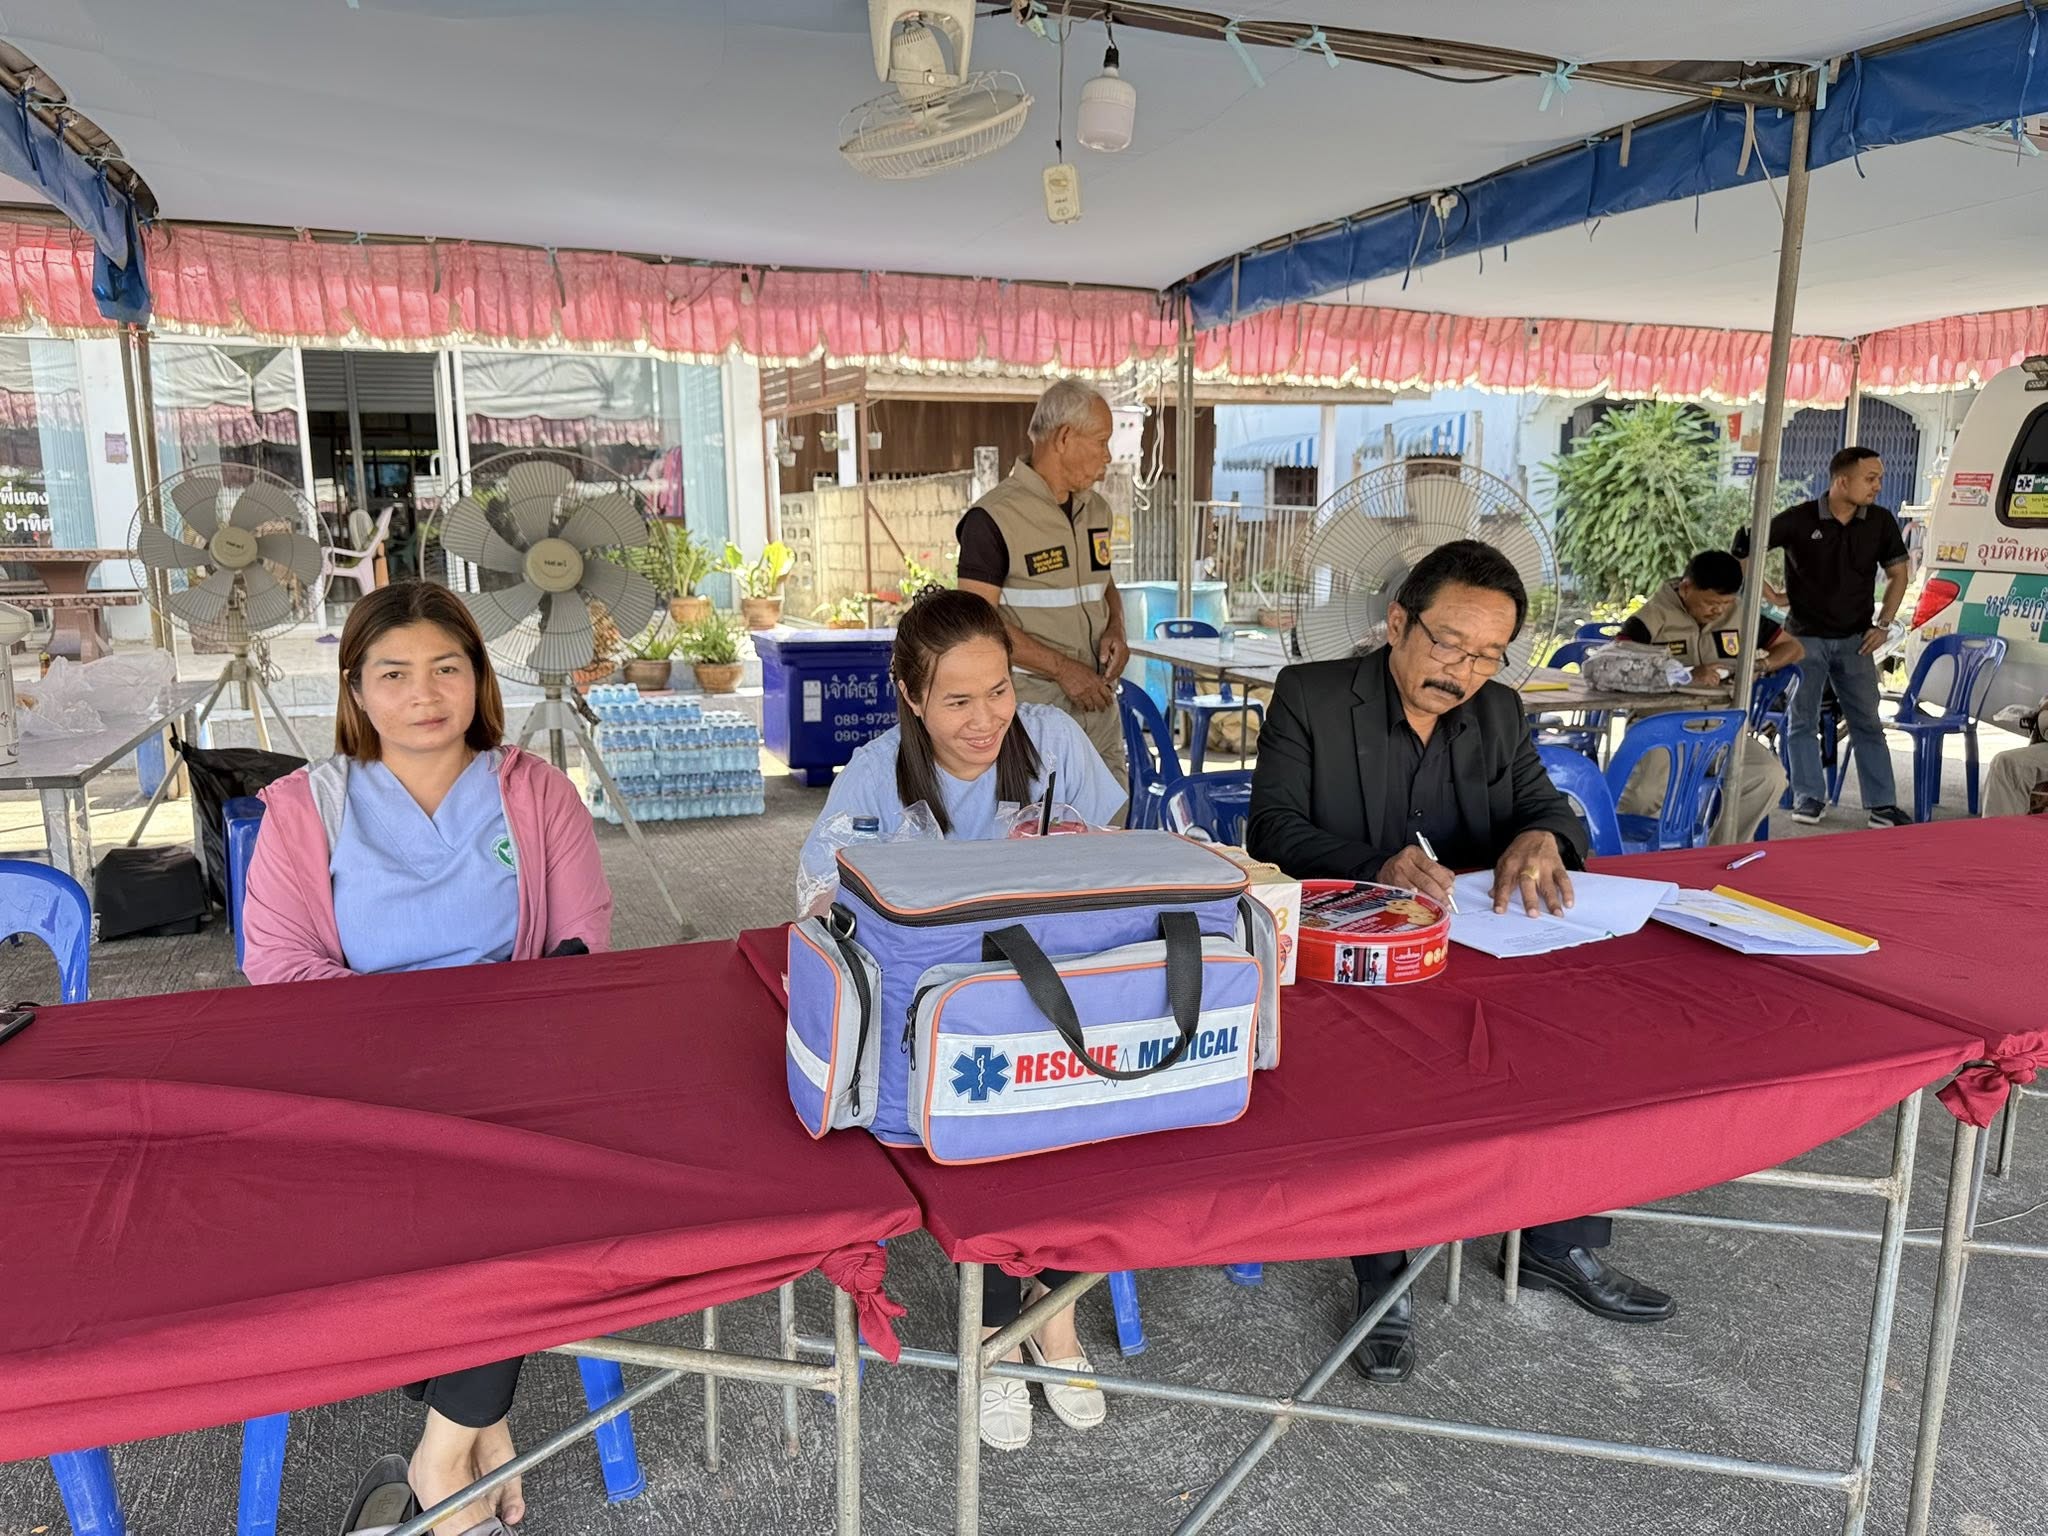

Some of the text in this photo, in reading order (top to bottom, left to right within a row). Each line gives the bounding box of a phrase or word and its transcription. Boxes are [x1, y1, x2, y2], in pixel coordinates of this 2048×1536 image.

[1984, 587, 2048, 632] หน่วยกู้
[1015, 1044, 1118, 1084] RESCUE
